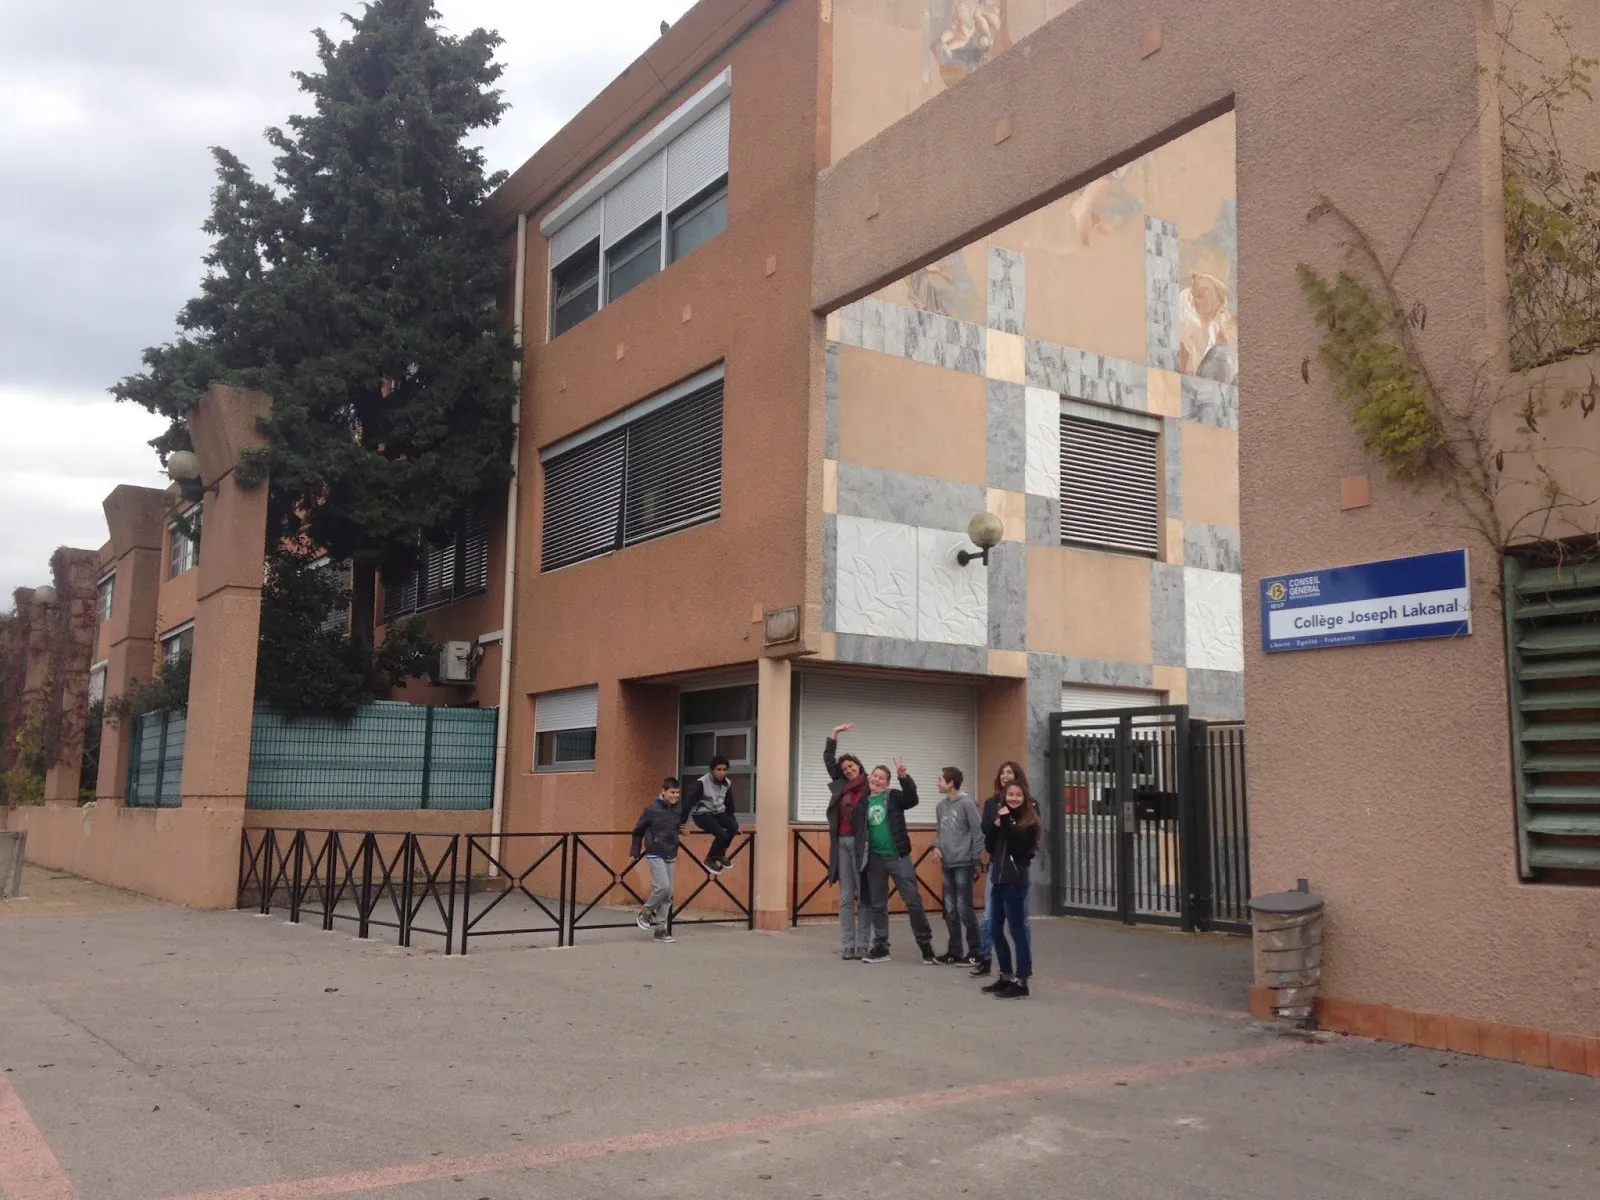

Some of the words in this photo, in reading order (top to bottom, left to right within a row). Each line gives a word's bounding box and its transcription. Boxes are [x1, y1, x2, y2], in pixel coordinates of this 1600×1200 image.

[1289, 576, 1321, 587] CONSEIL
[1289, 585, 1321, 596] GENERAL
[1294, 614, 1344, 630] Collège
[1348, 606, 1398, 624] Joseph
[1403, 598, 1459, 618] Lakanal
[1324, 635, 1356, 644] Fraternité
